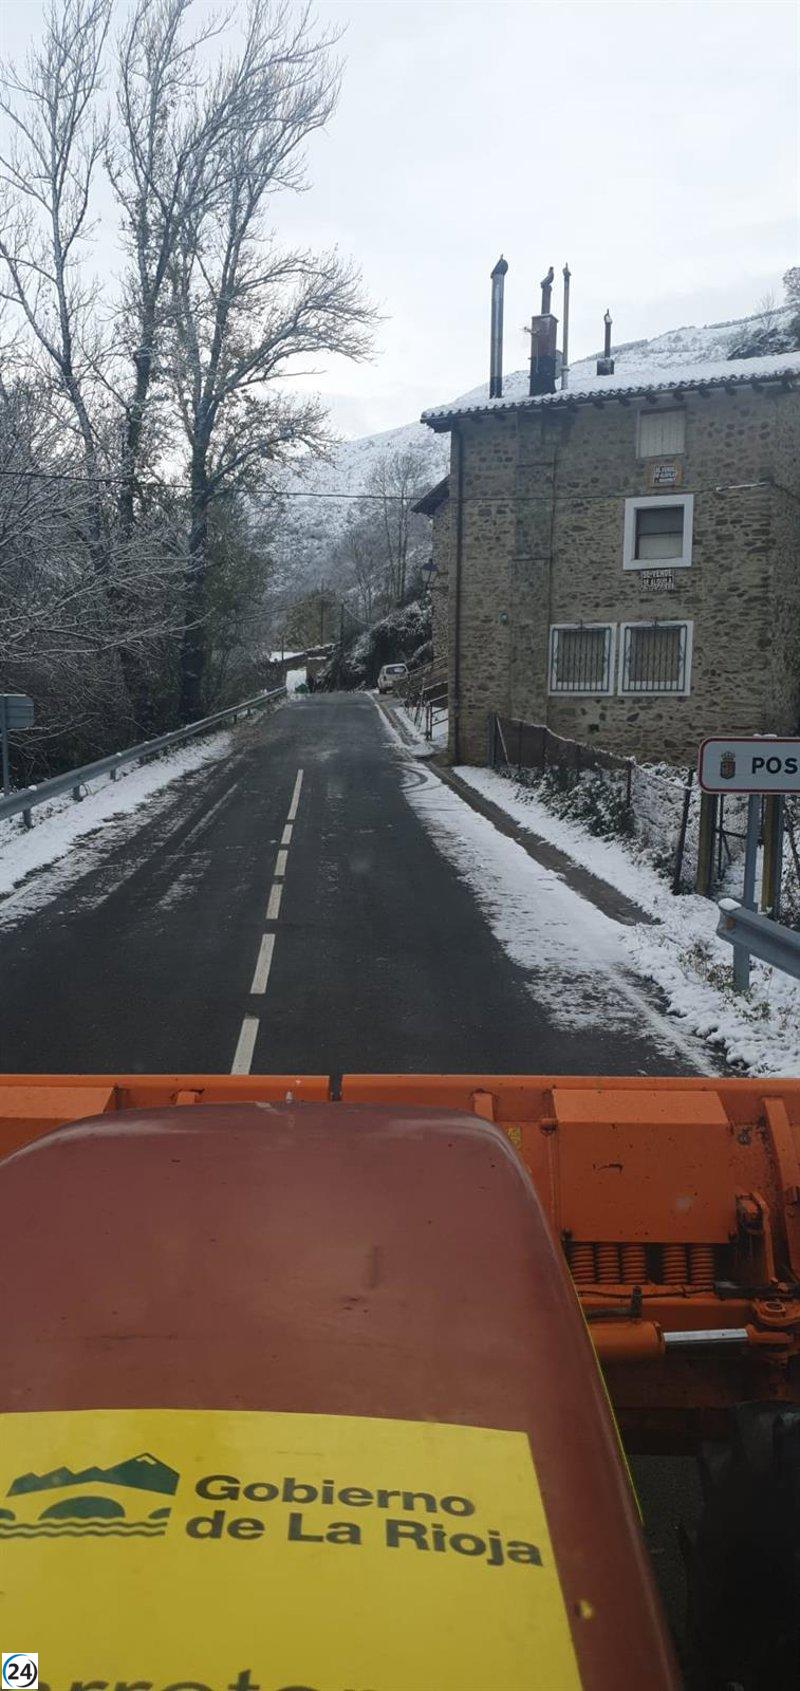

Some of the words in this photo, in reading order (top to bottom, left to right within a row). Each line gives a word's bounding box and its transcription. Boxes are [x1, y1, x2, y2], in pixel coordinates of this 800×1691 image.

[195, 1475, 476, 1517] Gobierno
[185, 1510, 265, 1540] de
[288, 1513, 362, 1545] La
[385, 1518, 544, 1567] Rioja
